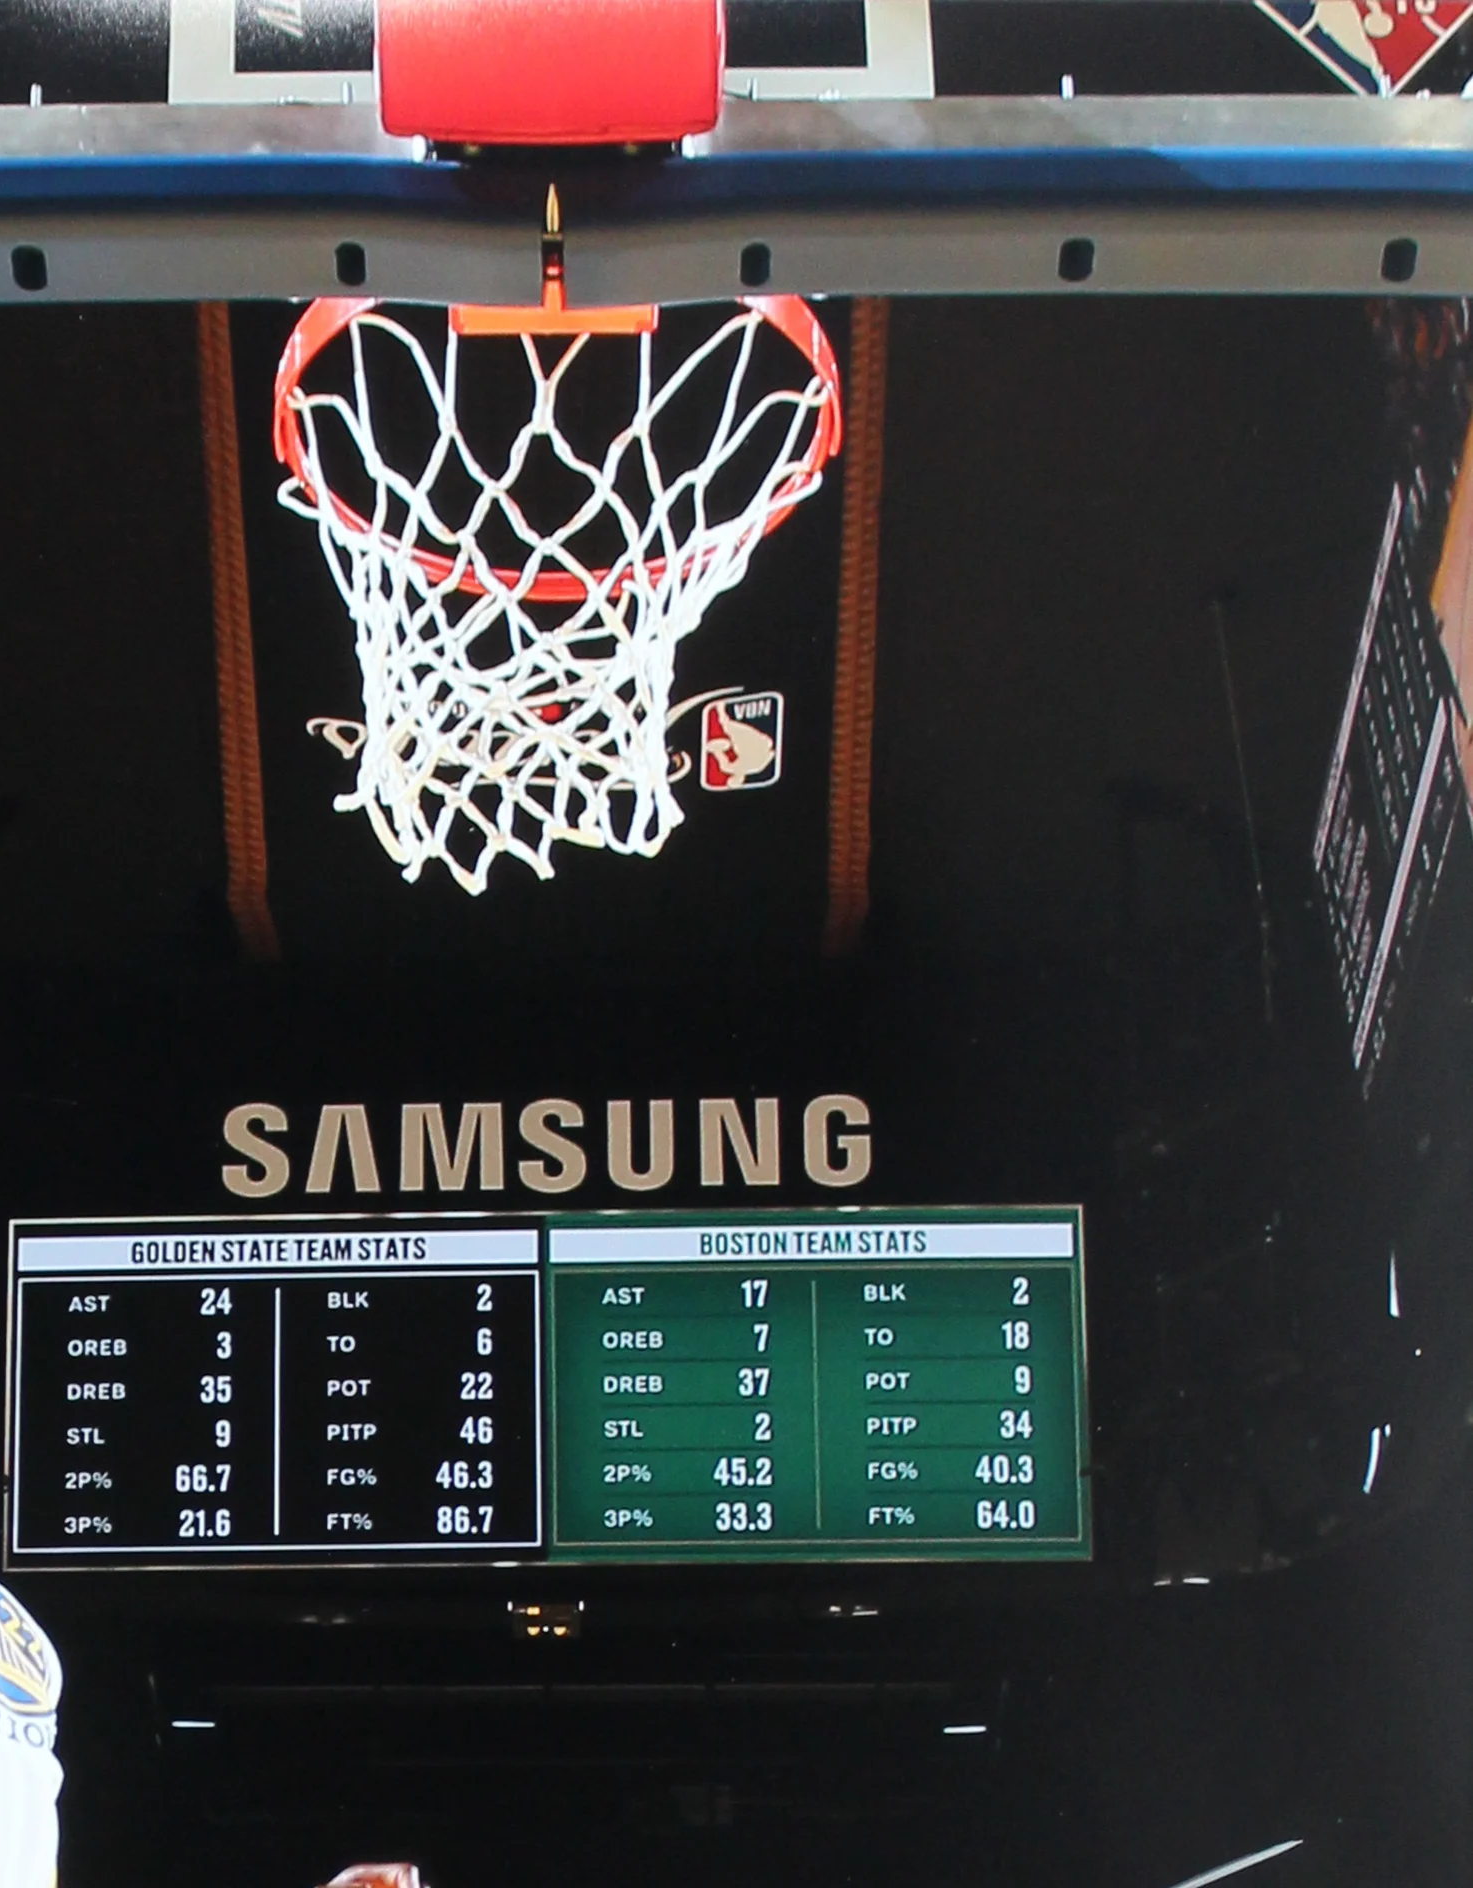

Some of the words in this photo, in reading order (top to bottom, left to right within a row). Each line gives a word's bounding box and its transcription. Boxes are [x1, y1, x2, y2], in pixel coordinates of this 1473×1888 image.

[221, 1094, 872, 1198] SAMSUNG
[131, 1240, 215, 1264] GOLDEN
[221, 1239, 288, 1262] STATE
[295, 1238, 354, 1262] TEAM
[358, 1237, 427, 1261] STATS
[699, 1232, 787, 1256] BOSTON
[793, 1231, 852, 1255] TEAM
[858, 1230, 927, 1254] STATS
[69, 1296, 110, 1312] AST
[201, 1288, 232, 1315] 24
[328, 1292, 368, 1308] BLK
[477, 1284, 492, 1311] 2
[602, 1288, 644, 1304] AST
[741, 1280, 767, 1307] 17
[864, 1284, 905, 1301] BLK
[1013, 1277, 1028, 1304] 2
[68, 1339, 126, 1356] OREB
[217, 1332, 231, 1358] 3
[327, 1336, 355, 1352] TO
[477, 1328, 492, 1355] 6
[603, 1331, 663, 1348] OREB
[754, 1324, 768, 1352] 7
[864, 1328, 893, 1345] TO
[1002, 1322, 1029, 1349] 18
[67, 1383, 125, 1400] DREB
[200, 1376, 231, 1403] 35
[328, 1380, 371, 1396] POT
[461, 1372, 493, 1399] 22
[604, 1376, 662, 1392] DREB
[739, 1368, 769, 1396] 37
[866, 1373, 910, 1389] POT
[1015, 1366, 1030, 1393] 9
[67, 1428, 104, 1444] STL
[216, 1420, 230, 1447] 9
[327, 1424, 376, 1441] PITP
[460, 1417, 492, 1444] 46
[605, 1420, 643, 1437] STL
[755, 1413, 770, 1440] 2
[867, 1417, 916, 1434] PITP
[1001, 1410, 1032, 1438] 34
[65, 1472, 111, 1489] 2P%
[176, 1464, 231, 1492] 66.7
[327, 1469, 377, 1485] FG%
[436, 1461, 492, 1488] 46.3
[604, 1465, 651, 1482] 2P%
[714, 1458, 772, 1486] 45.2
[868, 1462, 918, 1479] FG%
[975, 1455, 1033, 1483] 40.3
[65, 1517, 112, 1533] 3P%
[179, 1509, 230, 1537] 21.6
[327, 1514, 372, 1530] FT%
[437, 1506, 493, 1533] 86.7
[605, 1510, 652, 1527] 3P%
[716, 1503, 771, 1530] 33.3
[869, 1507, 914, 1524] FT%
[977, 1500, 1034, 1528] 64.0
